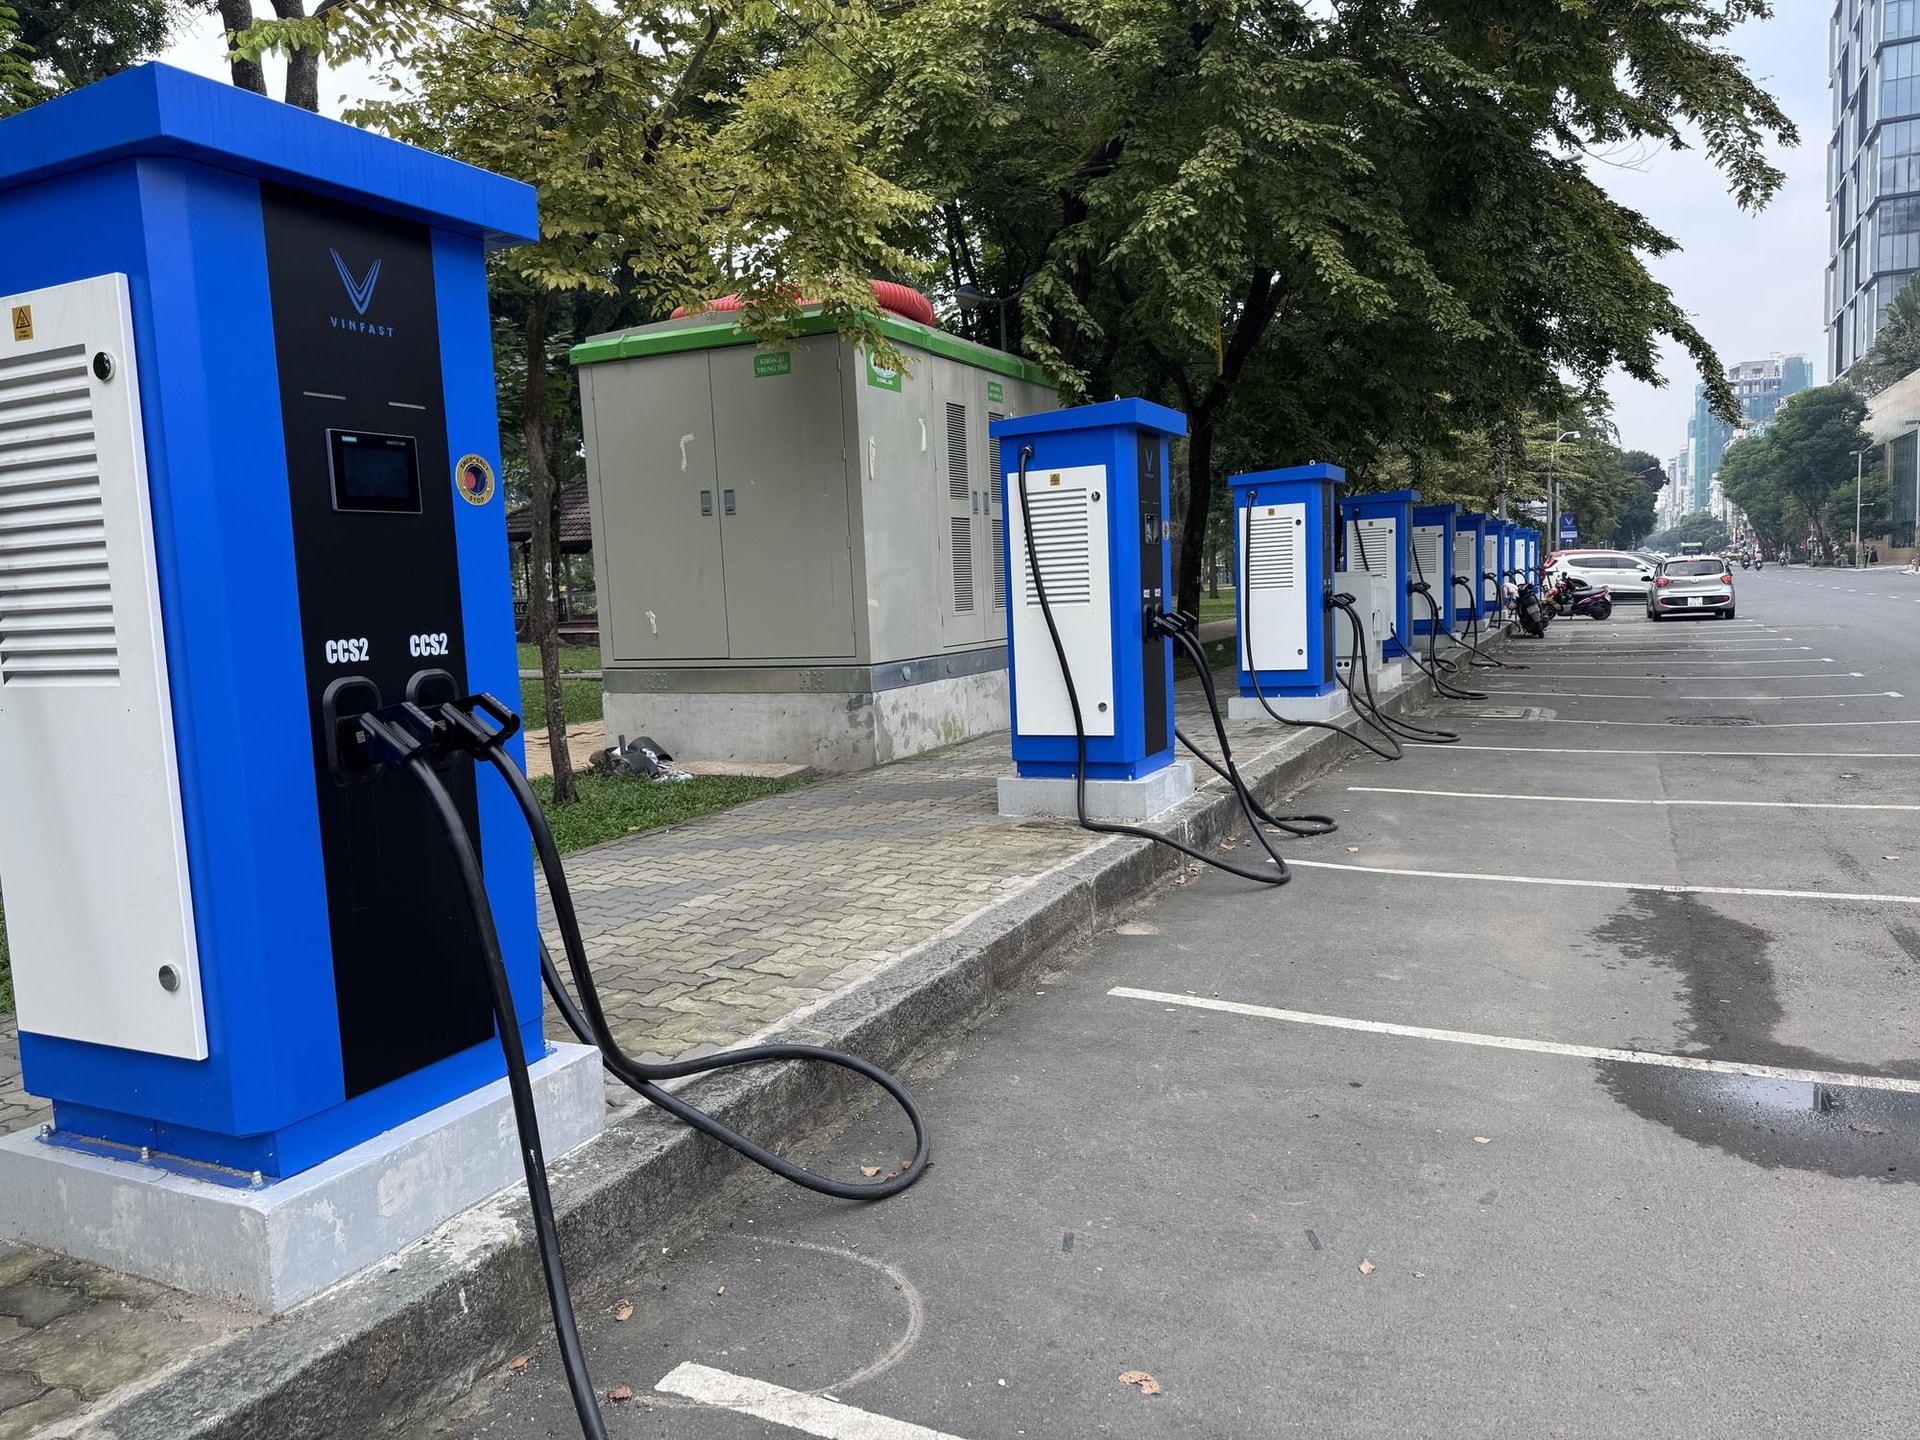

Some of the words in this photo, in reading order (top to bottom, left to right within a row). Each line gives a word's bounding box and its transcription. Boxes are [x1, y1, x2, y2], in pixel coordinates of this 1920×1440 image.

[329, 316, 394, 338] VINFAST
[460, 456, 489, 471] EMERGENCY
[469, 495, 485, 503] STOP
[325, 637, 370, 664] CCS2
[408, 632, 449, 658] CCS2
